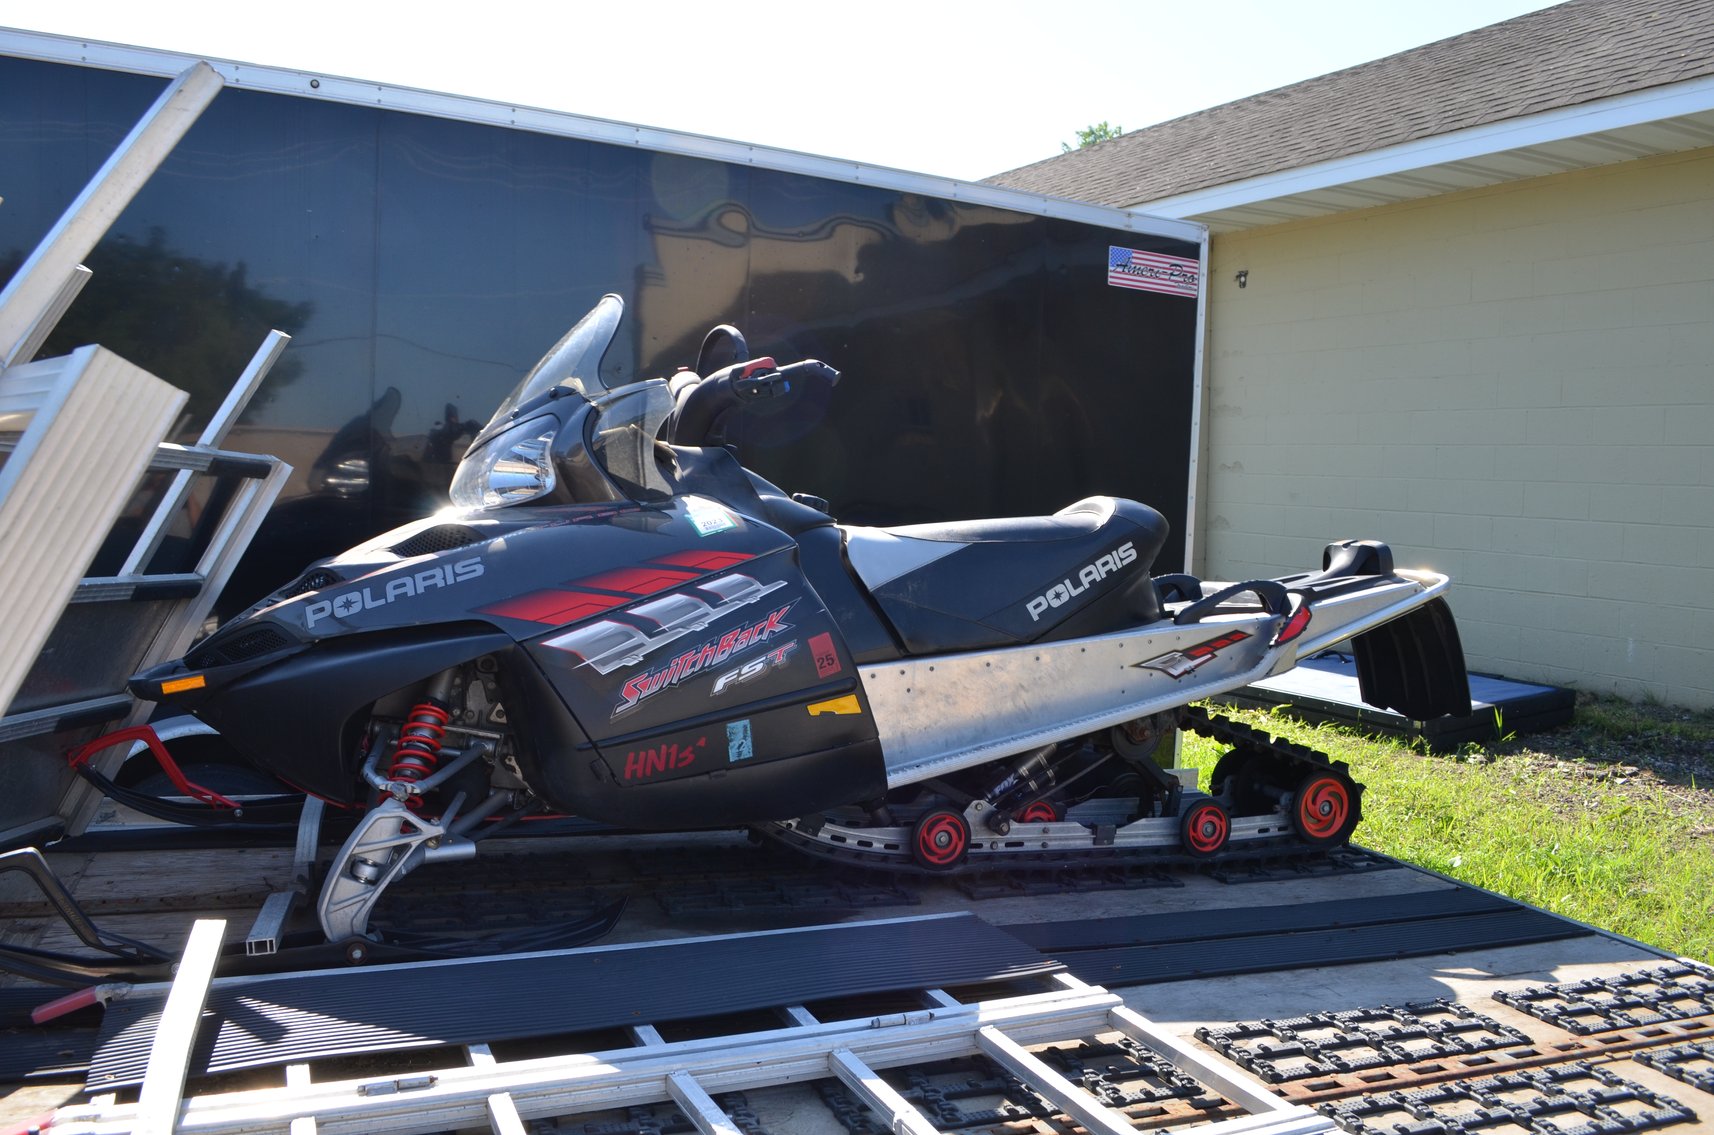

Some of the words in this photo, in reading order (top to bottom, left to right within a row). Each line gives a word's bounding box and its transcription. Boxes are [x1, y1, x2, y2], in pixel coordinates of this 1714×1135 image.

[304, 556, 485, 629] POLARIS
[1025, 541, 1138, 622] POLARIS
[711, 640, 797, 694] FST
[817, 653, 835, 670] 25
